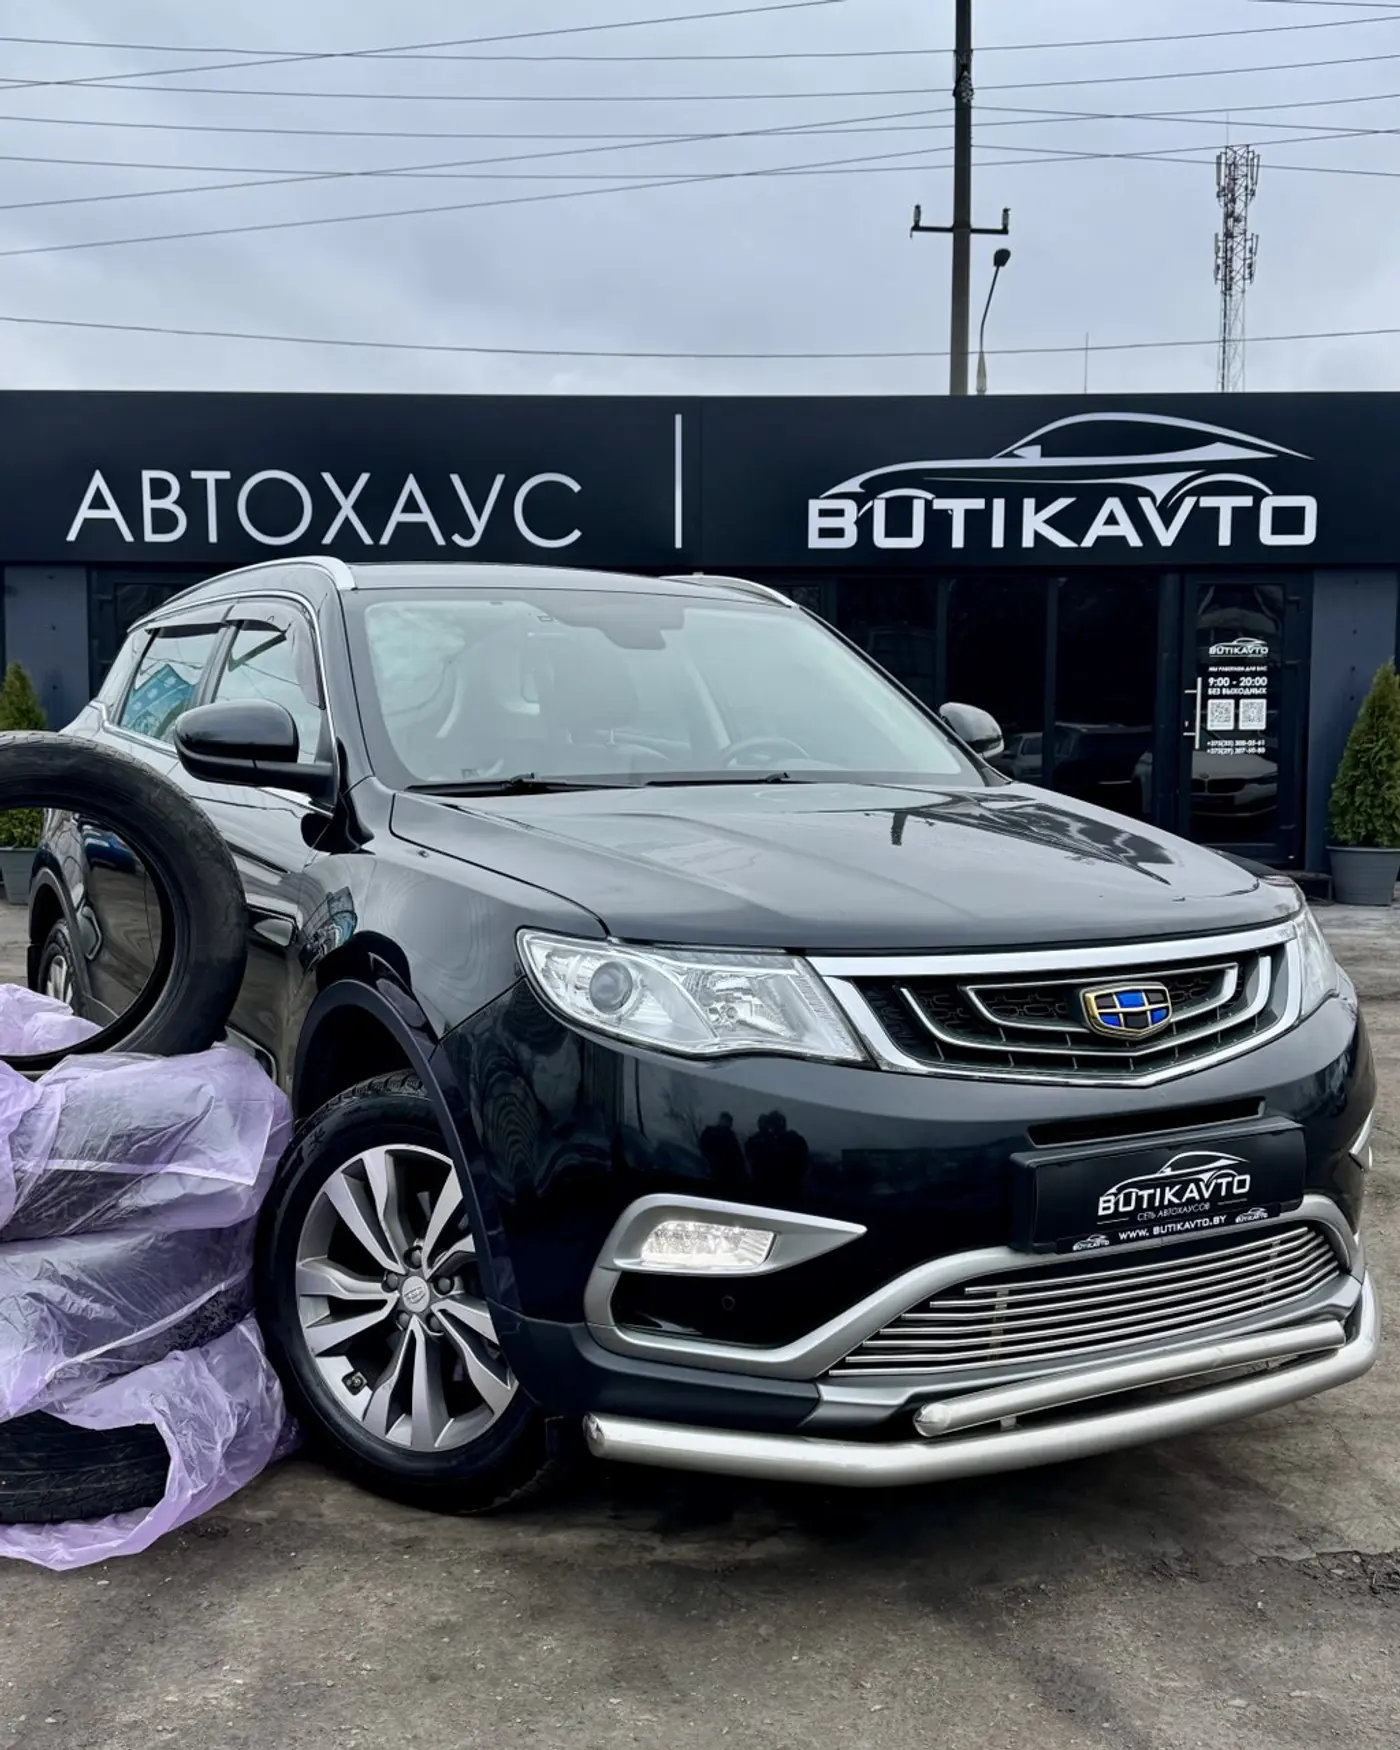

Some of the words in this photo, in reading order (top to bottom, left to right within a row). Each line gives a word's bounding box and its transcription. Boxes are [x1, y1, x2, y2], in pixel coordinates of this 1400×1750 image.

[66, 469, 583, 549] АВТОХАУС
[807, 494, 1318, 549] BUTIKAVTO
[1208, 676, 1230, 687] 9:00
[1239, 676, 1268, 687] 20:00
[1208, 687, 1221, 695] БЕЗ
[1222, 687, 1268, 695] ВЫХОДНЫХ
[1097, 1174, 1251, 1217] BUTIKAVTO
[1156, 1201, 1212, 1219] АВТОХАУСОВ
